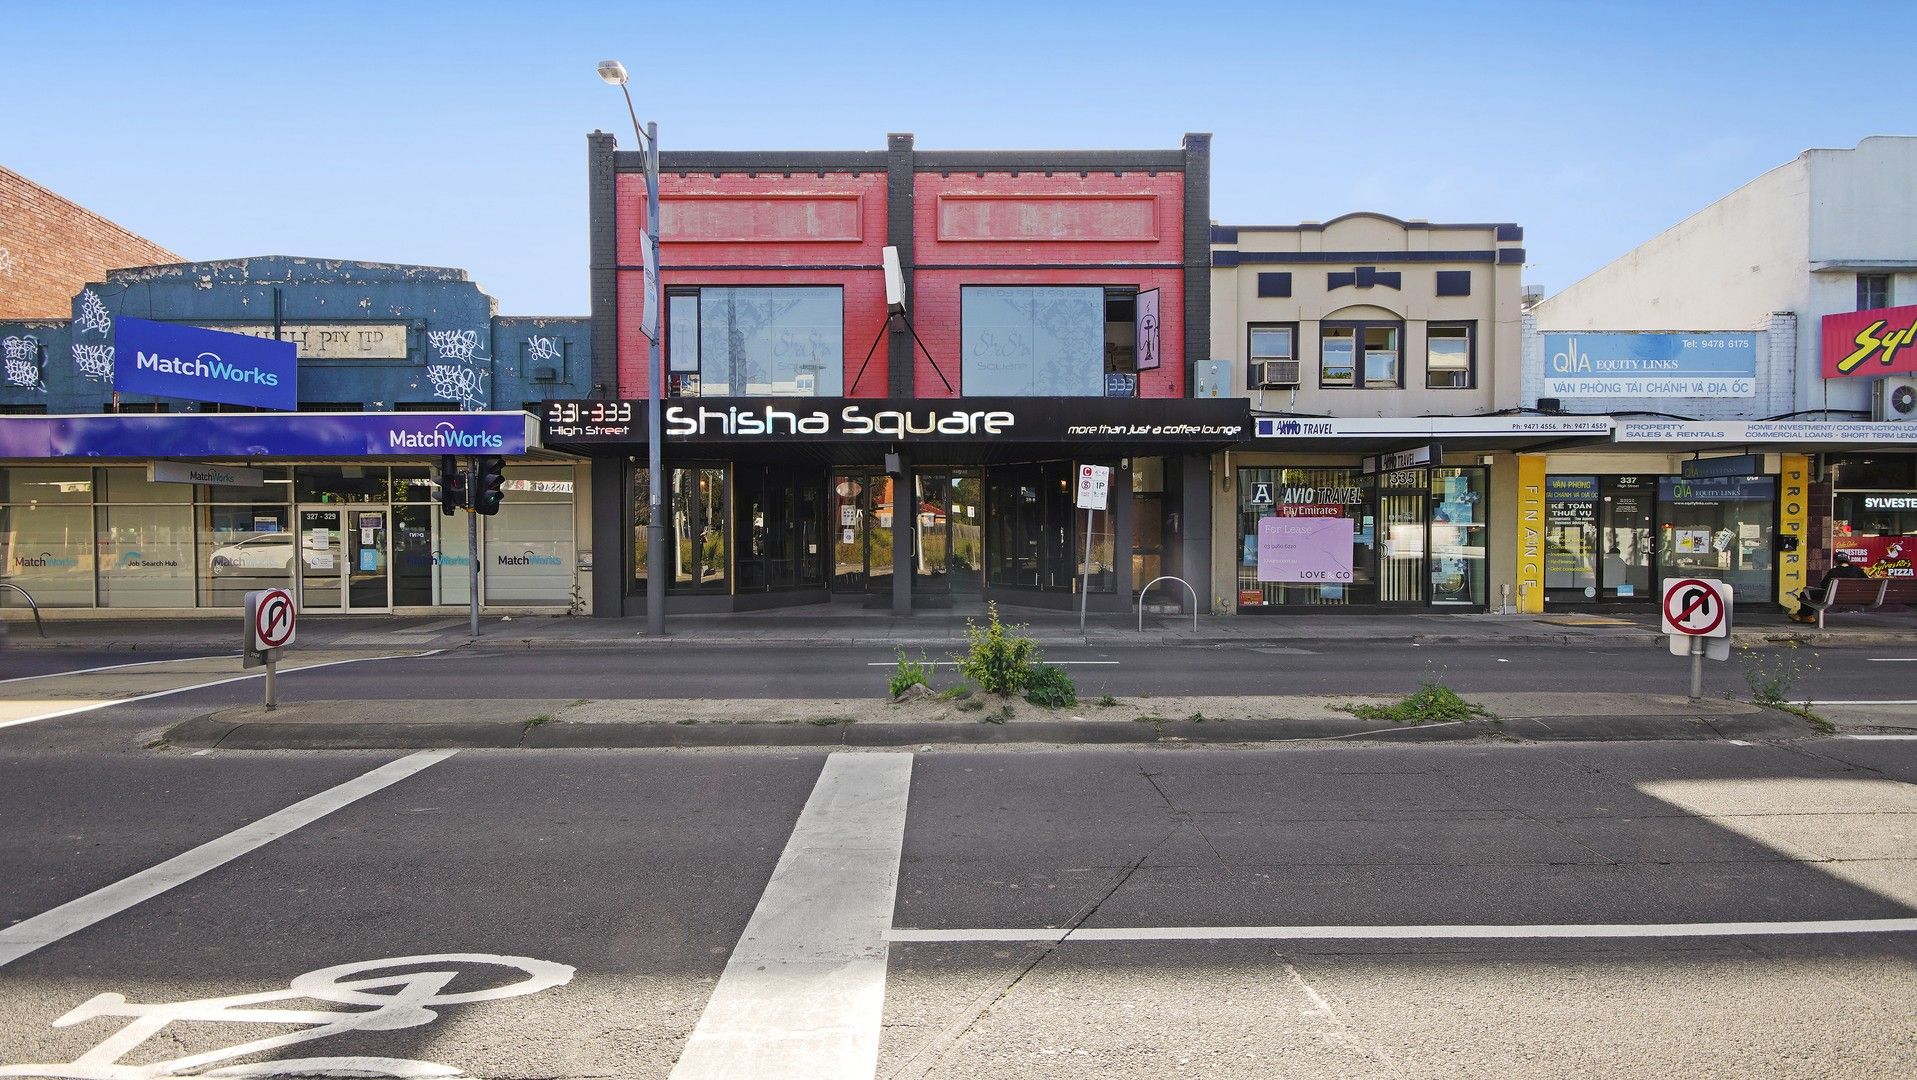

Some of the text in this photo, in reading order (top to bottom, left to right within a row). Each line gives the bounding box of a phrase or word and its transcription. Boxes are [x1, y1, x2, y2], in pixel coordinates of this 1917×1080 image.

[319, 331, 350, 351] PTY
[357, 331, 384, 351] LTD
[1682, 340, 1749, 348] Tel: 9478 6175
[137, 352, 278, 387] MatchWorks
[1596, 360, 1679, 370] EQUITY LINKS
[1109, 378, 1134, 391] 333
[666, 406, 1015, 439] Shisha Square
[1562, 422, 1573, 430] Ph:
[1574, 422, 1590, 430] 9471
[389, 422, 503, 448] MatchWorks
[549, 425, 629, 437] High Street
[1068, 424, 1242, 436] more than just a coffee lounge
[1303, 423, 1333, 435] TRAVEL
[190, 469, 235, 482] MatchWorks
[1390, 472, 1415, 485] 335
[1620, 476, 1637, 484] 337
[1252, 484, 1272, 503] A
[1283, 487, 1362, 505] AVIO TRAVEL
[1865, 497, 1917, 508] SYLVESTE
[1299, 506, 1338, 515] Emirates
[1265, 525, 1312, 534] For Lease
[1524, 485, 1539, 588] FINANCE
[1786, 471, 1801, 601] PROPRTY
[127, 559, 177, 567] Job Search Hub
[498, 551, 561, 565] MatchWorks
[1300, 571, 1325, 579] LOVE
[1335, 571, 1350, 579] CO
[1888, 568, 1914, 577] PIZZA
